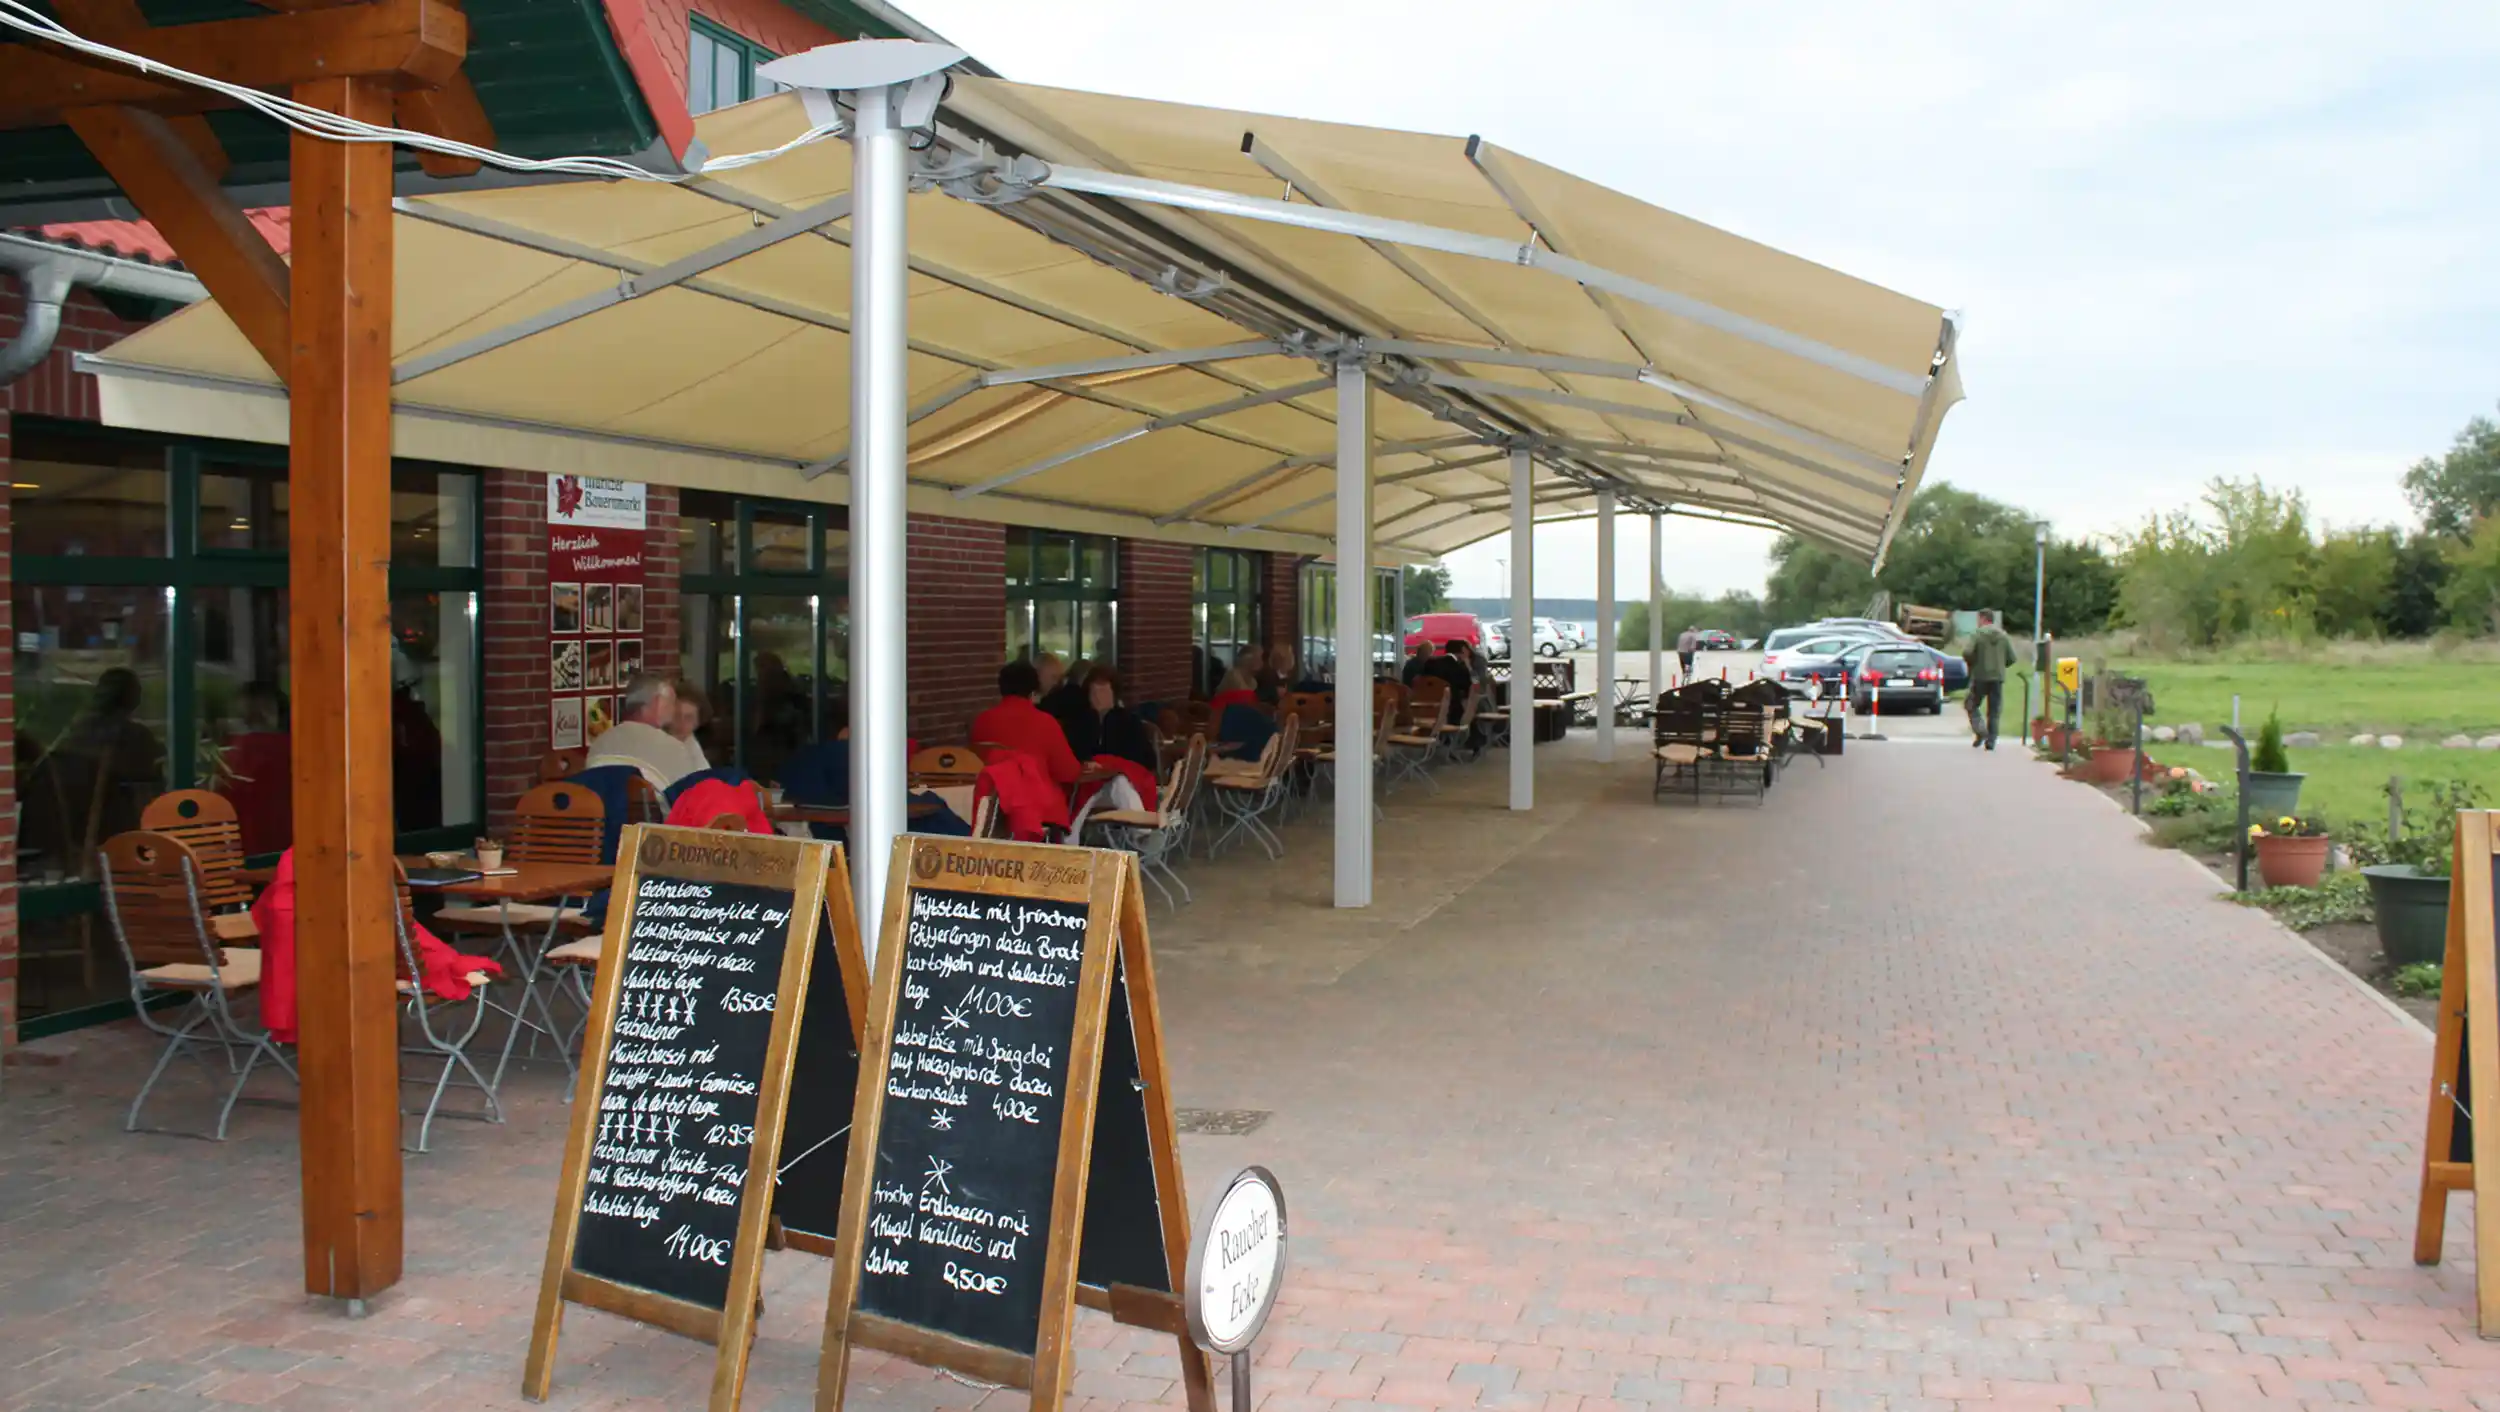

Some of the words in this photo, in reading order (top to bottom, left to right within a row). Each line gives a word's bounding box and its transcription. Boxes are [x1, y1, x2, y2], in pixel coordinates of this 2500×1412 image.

[552, 532, 600, 552] Herzlich
[572, 551, 642, 572] Willkommen!
[668, 842, 738, 870] ERDINGER
[946, 852, 1025, 883] ERDINGER
[639, 879, 713, 899] Gebratenes
[761, 908, 792, 929] auf
[912, 892, 982, 921] Hüftsteak
[986, 901, 1011, 923] mit
[1011, 905, 1087, 936] frischen
[732, 928, 765, 946] mit
[996, 931, 1034, 956] dazu
[716, 952, 756, 974] dazu
[907, 952, 974, 978] kartoffeln
[978, 959, 1004, 978] und
[623, 966, 704, 998] Salatbeilage
[905, 974, 930, 1010] lage
[720, 986, 776, 1013] 13,50€
[614, 1014, 687, 1041] Gebratener
[689, 1039, 720, 1064] mit
[895, 1020, 957, 1053] Leberkäse
[963, 1034, 984, 1056] mit
[986, 1037, 1054, 1073] Spiegelei
[891, 1052, 913, 1078] auf
[916, 1052, 1004, 1086] Holzofenbrot
[1009, 1072, 1053, 1098] dazu
[601, 1091, 628, 1111] dazu
[632, 1089, 721, 1122] Salatbeilage
[887, 1077, 969, 1106] Gurkensalat
[592, 1139, 661, 1164] Gebratener
[587, 1164, 611, 1184] mit
[702, 1183, 738, 1206] dazu
[584, 1190, 661, 1228] Salatbeilage
[919, 1190, 994, 1226] Erdbeeren
[997, 1209, 1030, 1237] mit
[987, 1236, 1017, 1260] und
[1219, 1208, 1270, 1270] Raucher
[1230, 1271, 1260, 1322] Ecke
